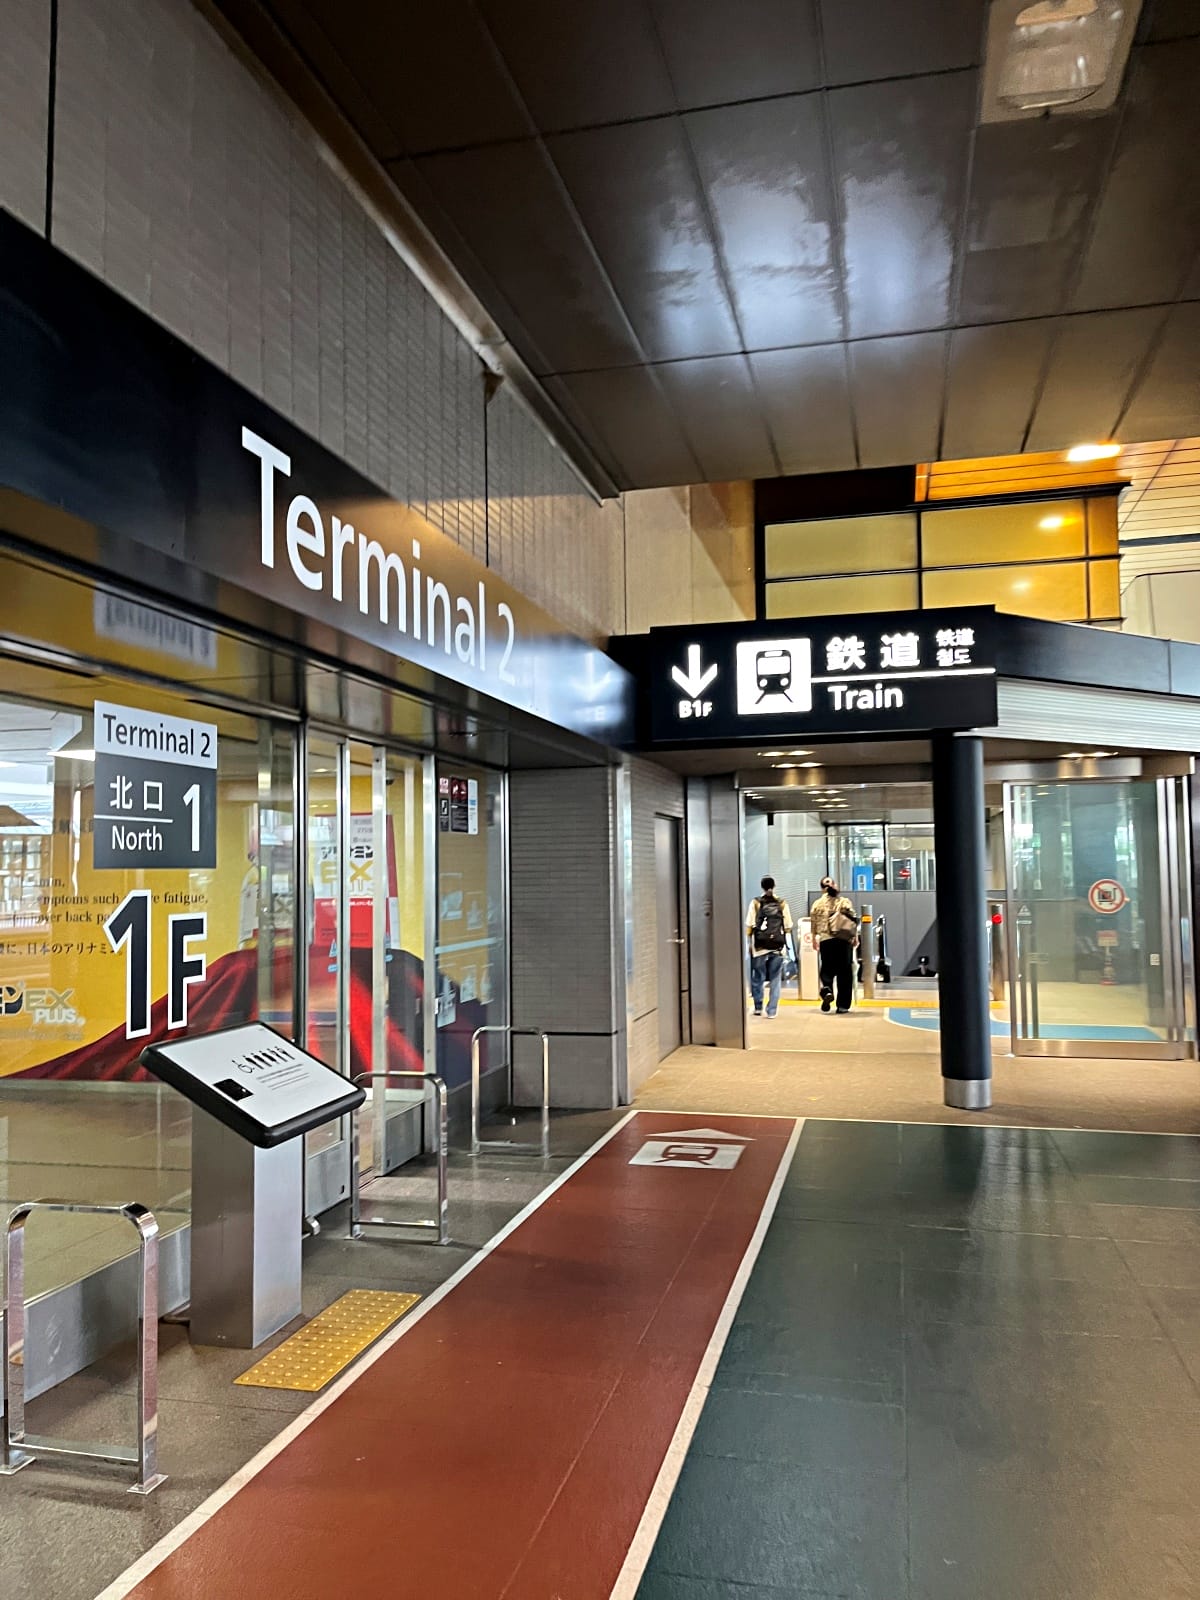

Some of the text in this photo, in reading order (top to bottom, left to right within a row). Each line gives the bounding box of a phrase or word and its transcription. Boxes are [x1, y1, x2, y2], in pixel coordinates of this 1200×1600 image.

[241, 425, 517, 685] Terminal 2
[825, 632, 921, 671] 鉄道
[678, 700, 713, 719] B1F
[827, 683, 904, 711] Train
[103, 714, 211, 758] Terminal 2
[109, 775, 163, 812] 北口
[182, 783, 201, 852] 1
[111, 825, 163, 851] North
[93, 892, 119, 904] such
[164, 891, 208, 906] fatigue,
[103, 889, 208, 1040] 1F
